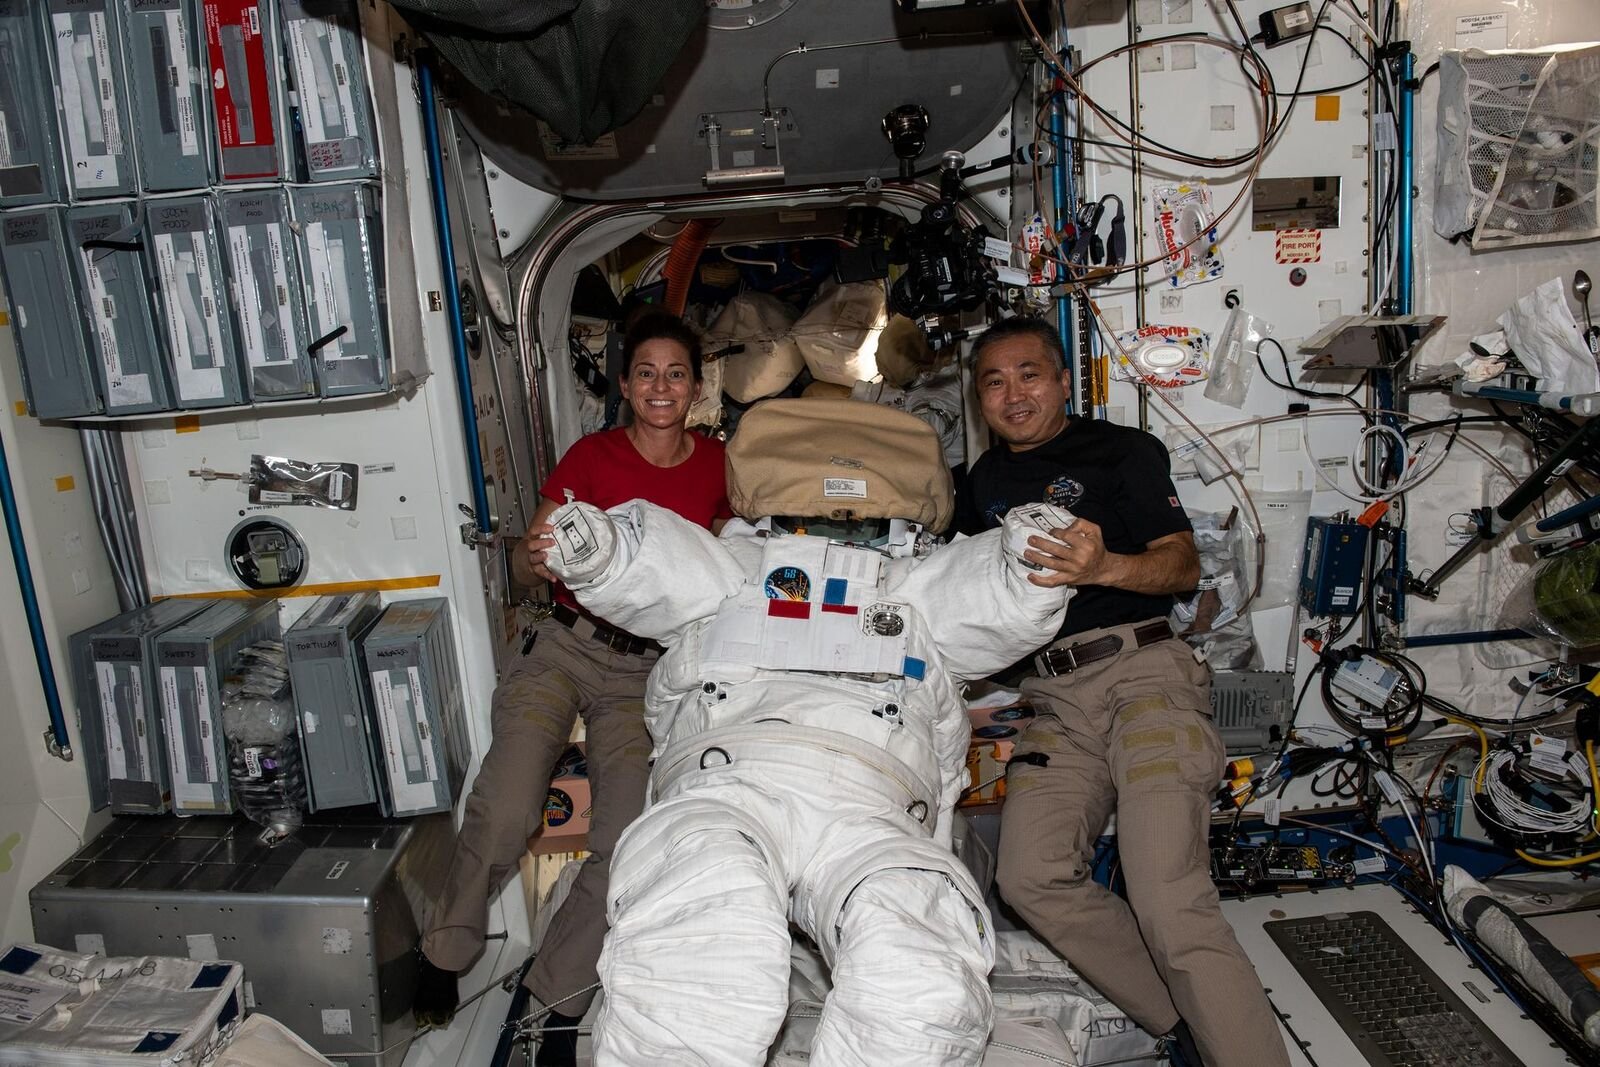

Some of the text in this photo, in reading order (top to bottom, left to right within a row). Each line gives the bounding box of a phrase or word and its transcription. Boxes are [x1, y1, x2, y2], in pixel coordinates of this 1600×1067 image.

[1161, 295, 1181, 309] DRY
[783, 568, 796, 579] 68
[296, 640, 338, 651] TORTILLAS
[164, 650, 196, 658] SWEETS
